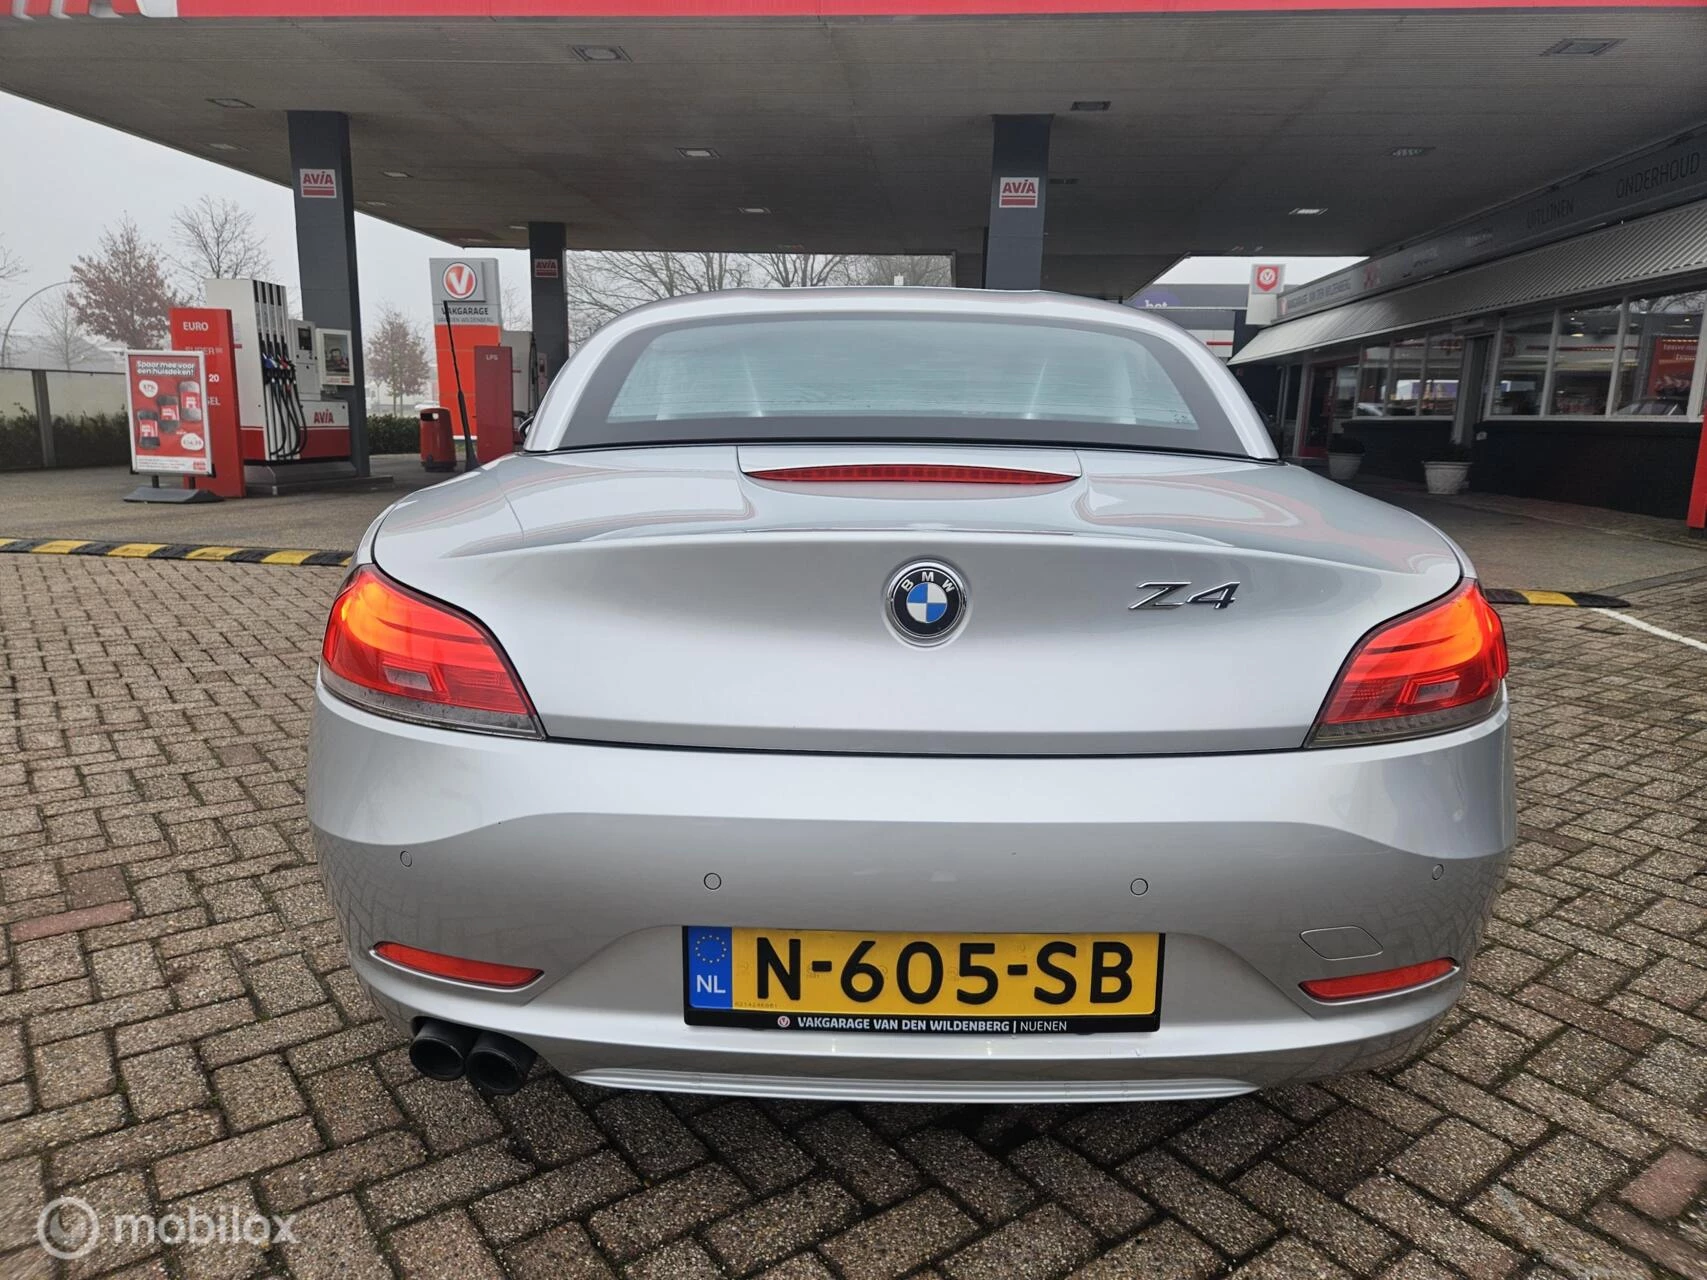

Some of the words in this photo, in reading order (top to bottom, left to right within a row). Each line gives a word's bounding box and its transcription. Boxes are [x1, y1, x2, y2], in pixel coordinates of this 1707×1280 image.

[1616, 152, 1700, 199] ONDERHOUD
[1002, 179, 1036, 194] AVIA
[183, 321, 209, 331] EURO
[901, 571, 956, 594] BMW
[1127, 581, 1241, 610] Z4
[756, 936, 1134, 1006] N-605-SB
[696, 974, 726, 994] NL
[797, 1016, 870, 1030] VAKGARAGE
[873, 1018, 898, 1031] VAN
[901, 1019, 927, 1031] DEN
[930, 1020, 1010, 1032] WILDENBERG
[1020, 1020, 1067, 1032] NUENEN
